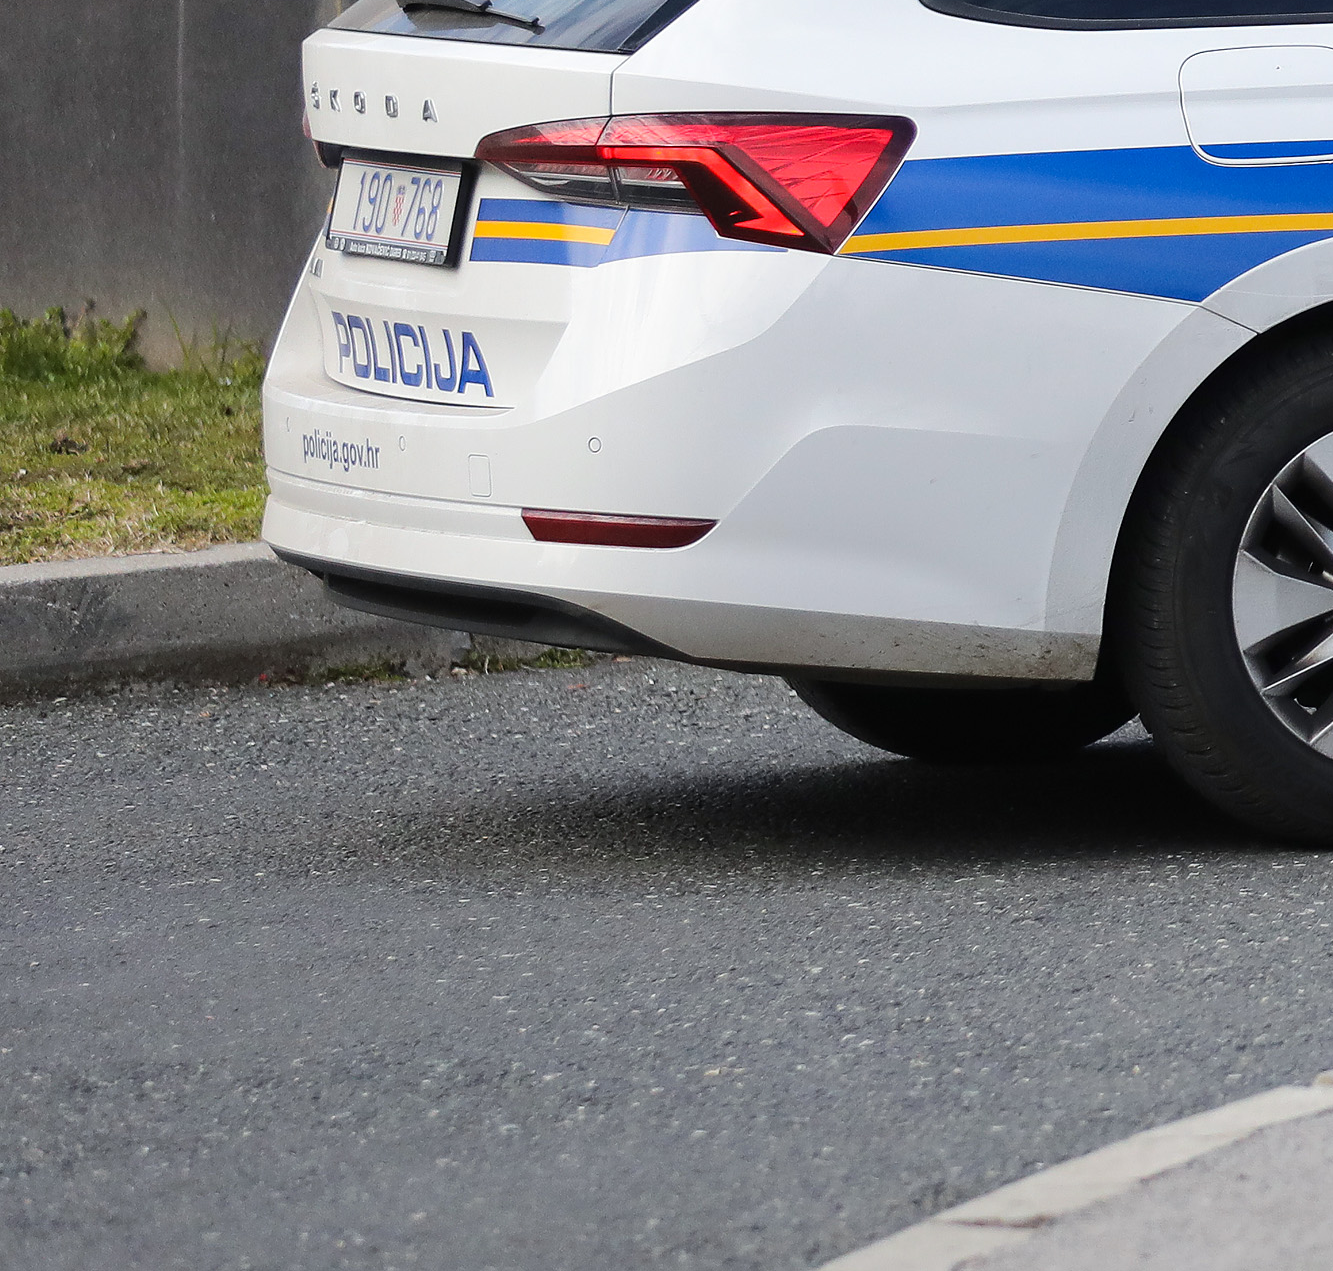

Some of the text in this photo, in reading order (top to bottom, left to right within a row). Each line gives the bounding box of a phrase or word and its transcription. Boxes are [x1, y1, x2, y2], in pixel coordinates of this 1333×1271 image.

[311, 81, 438, 123] ŠKODA
[353, 171, 443, 241] 190 768
[332, 311, 495, 398] POLICIJA
[303, 429, 380, 472] policija.gov.hr
